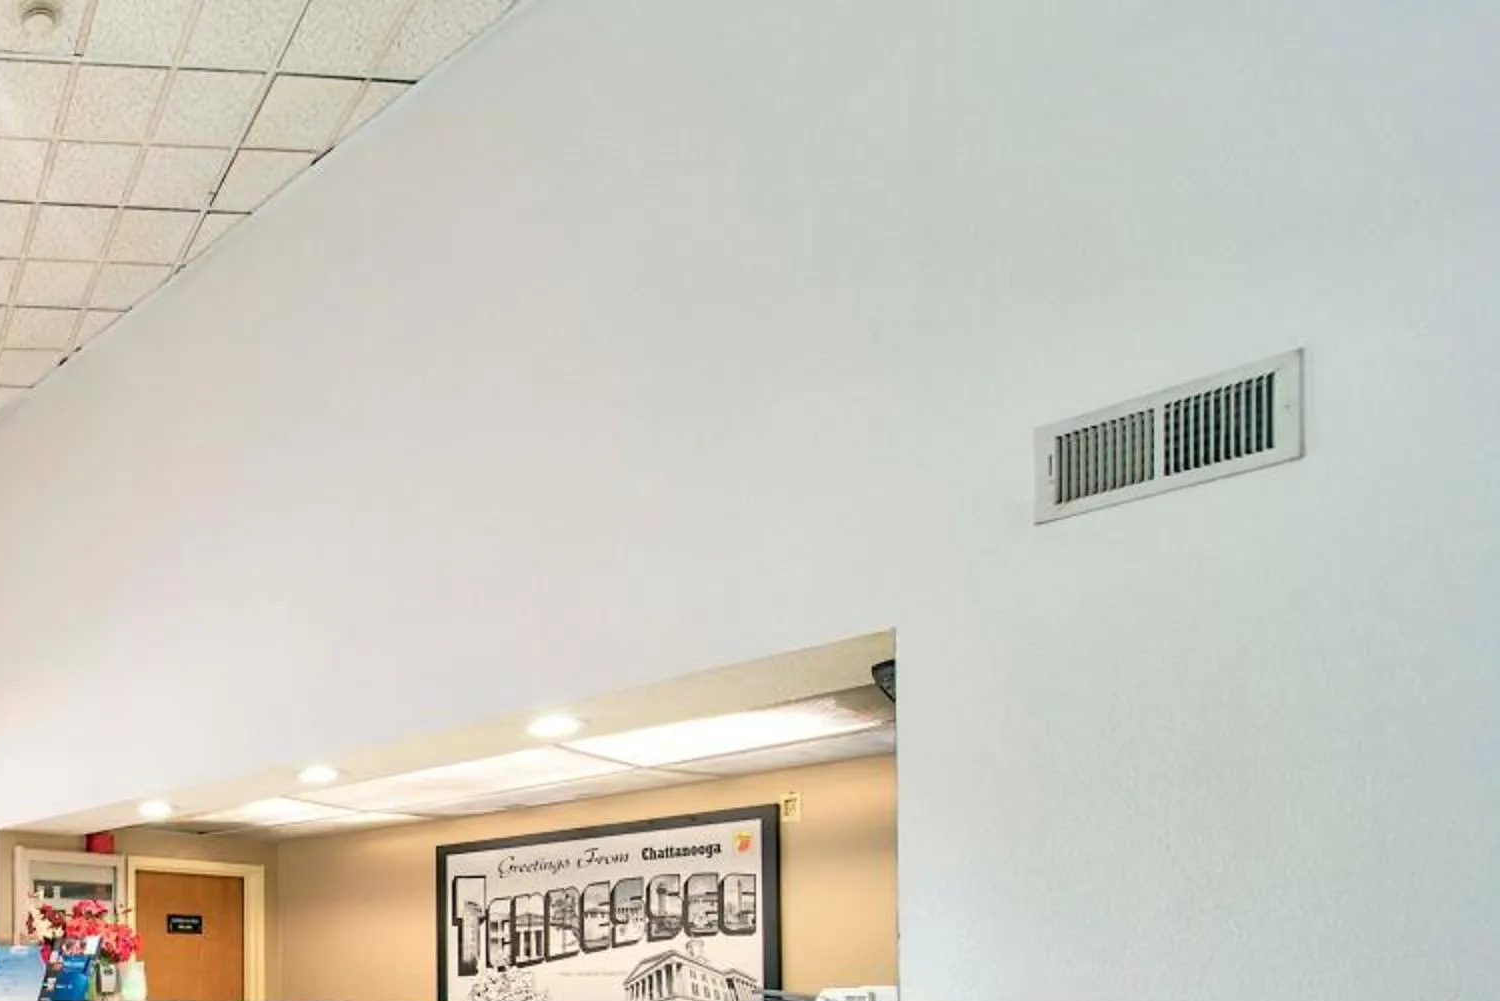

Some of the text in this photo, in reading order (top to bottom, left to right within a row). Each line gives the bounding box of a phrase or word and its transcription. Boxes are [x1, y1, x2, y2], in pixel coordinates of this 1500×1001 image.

[497, 855, 571, 879] Greetings
[577, 847, 630, 868] From
[641, 842, 722, 861] Chattanooga
